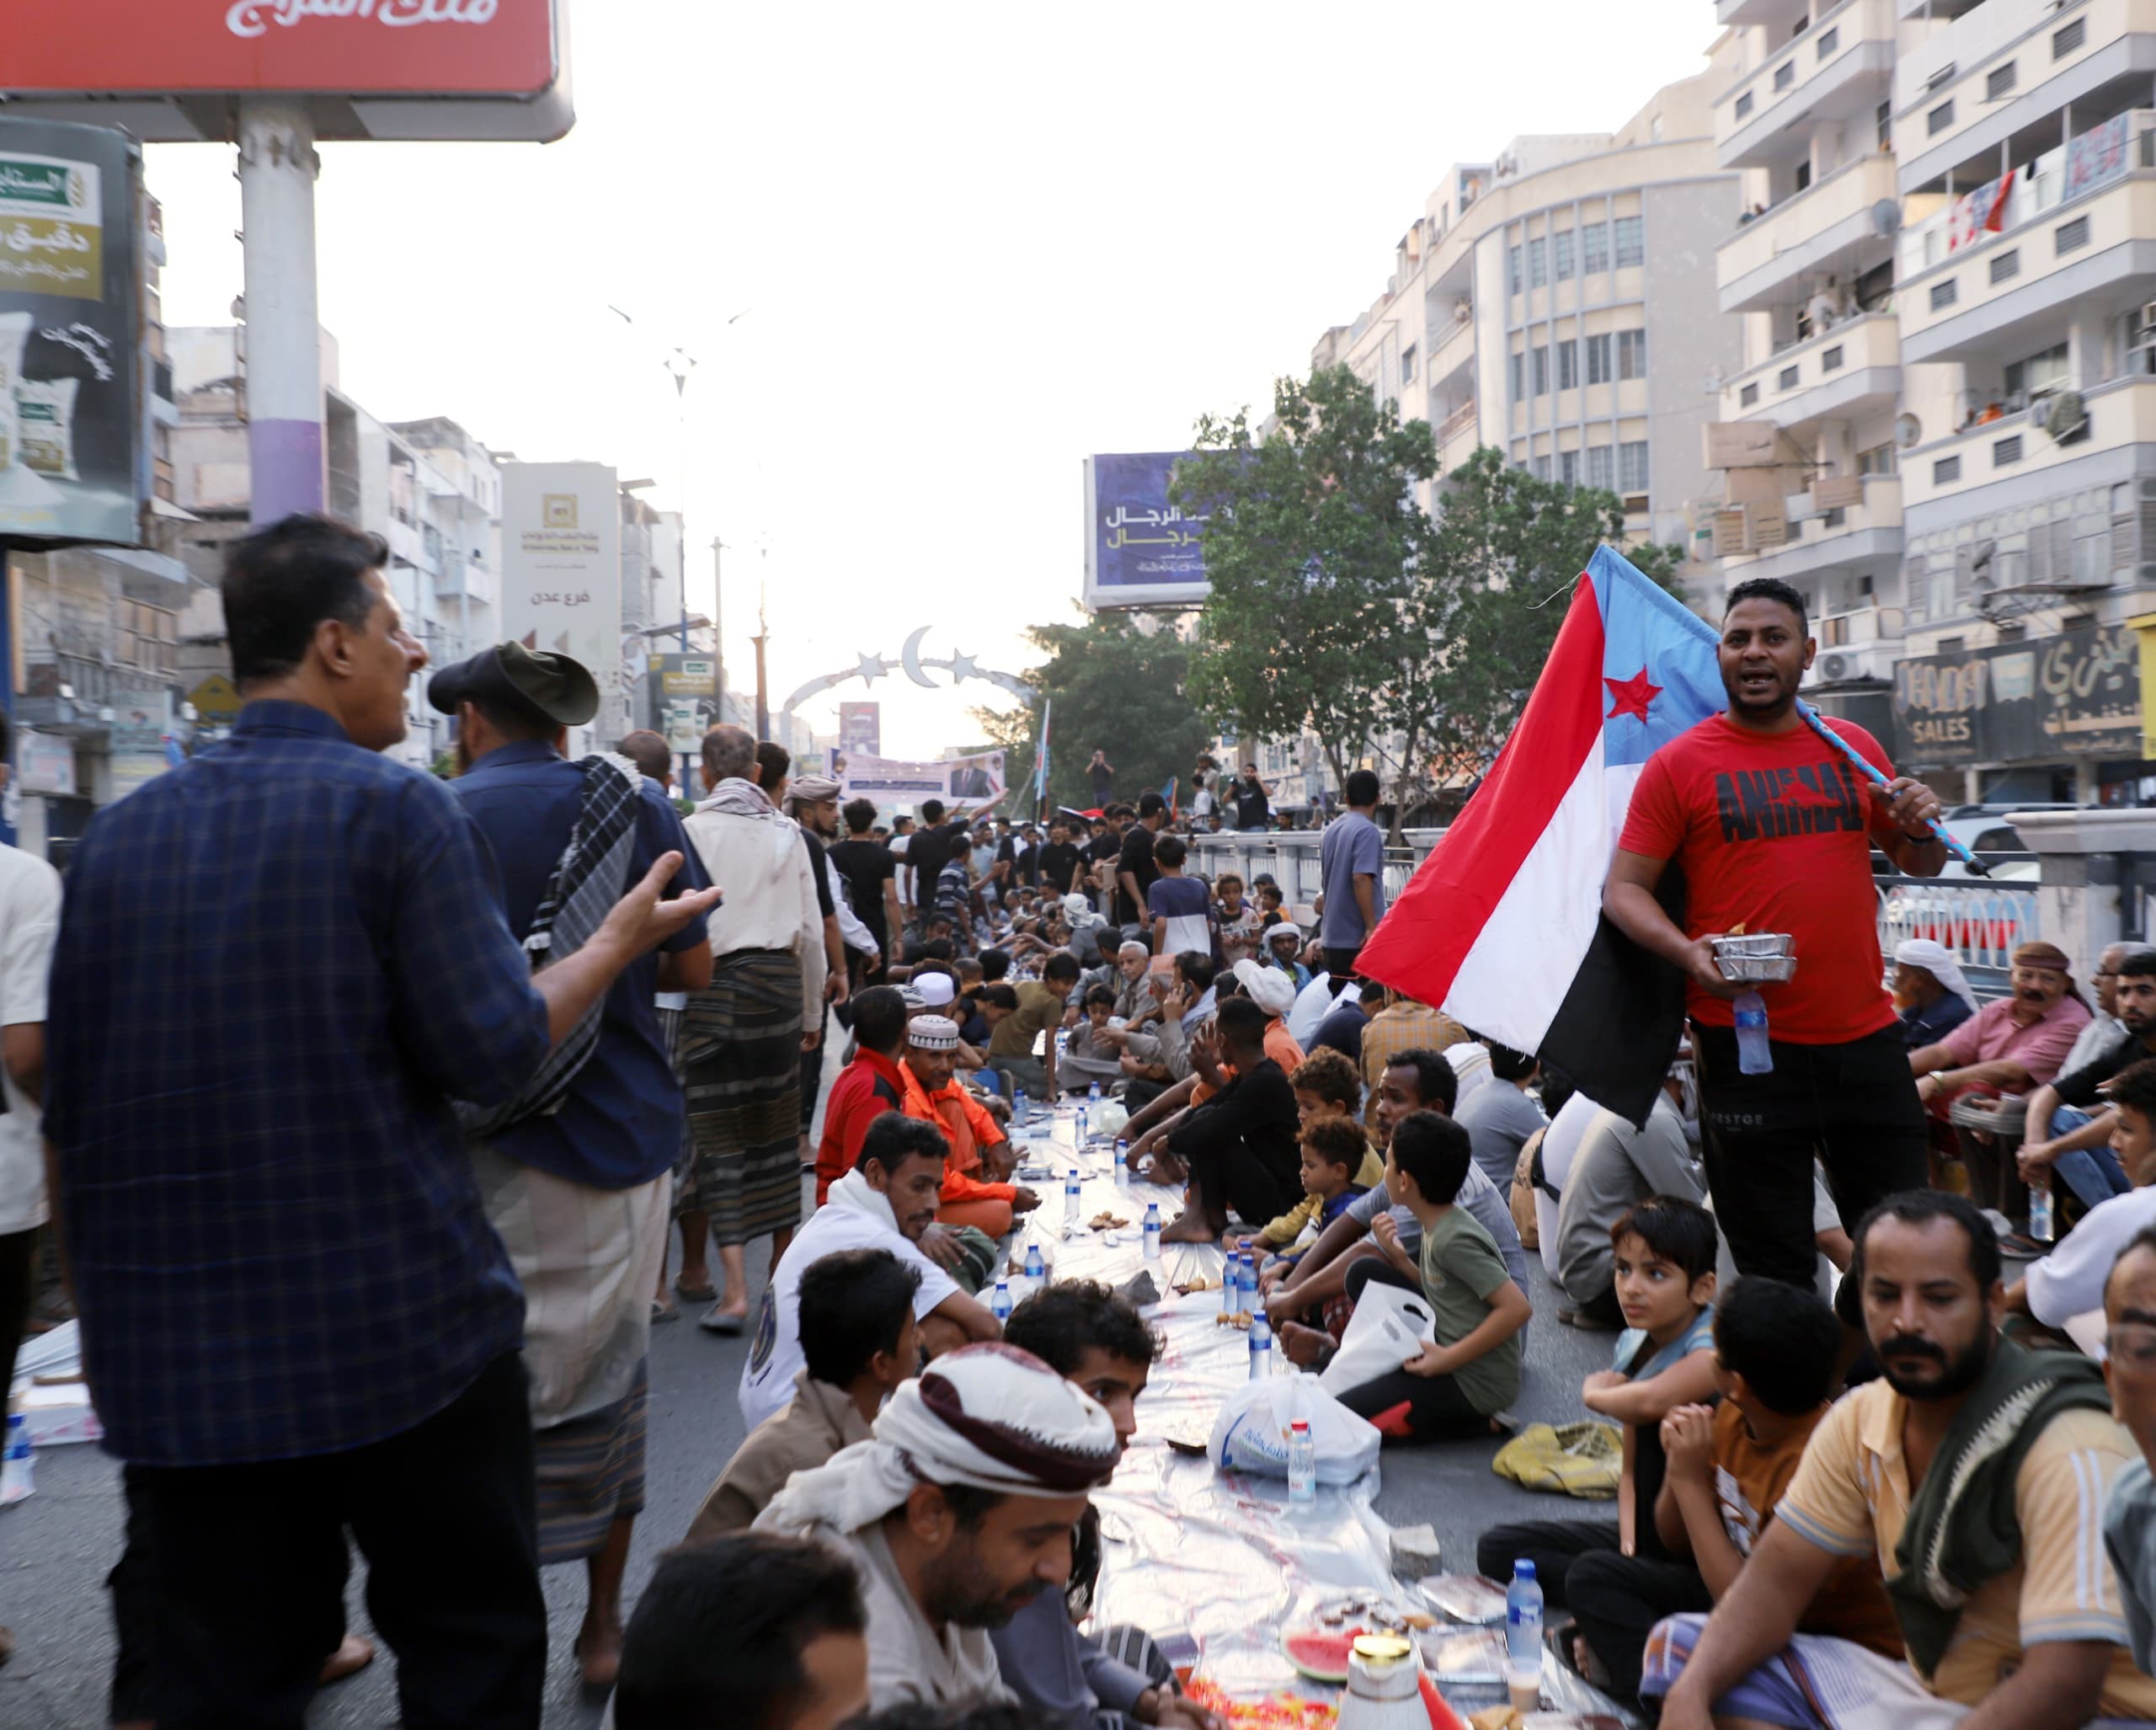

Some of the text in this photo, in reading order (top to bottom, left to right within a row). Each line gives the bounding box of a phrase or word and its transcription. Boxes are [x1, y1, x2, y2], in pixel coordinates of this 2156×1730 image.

[1105, 505, 1181, 528] الرجال
[1106, 527, 1201, 549] رجال
[1913, 717, 1972, 744] SALES
